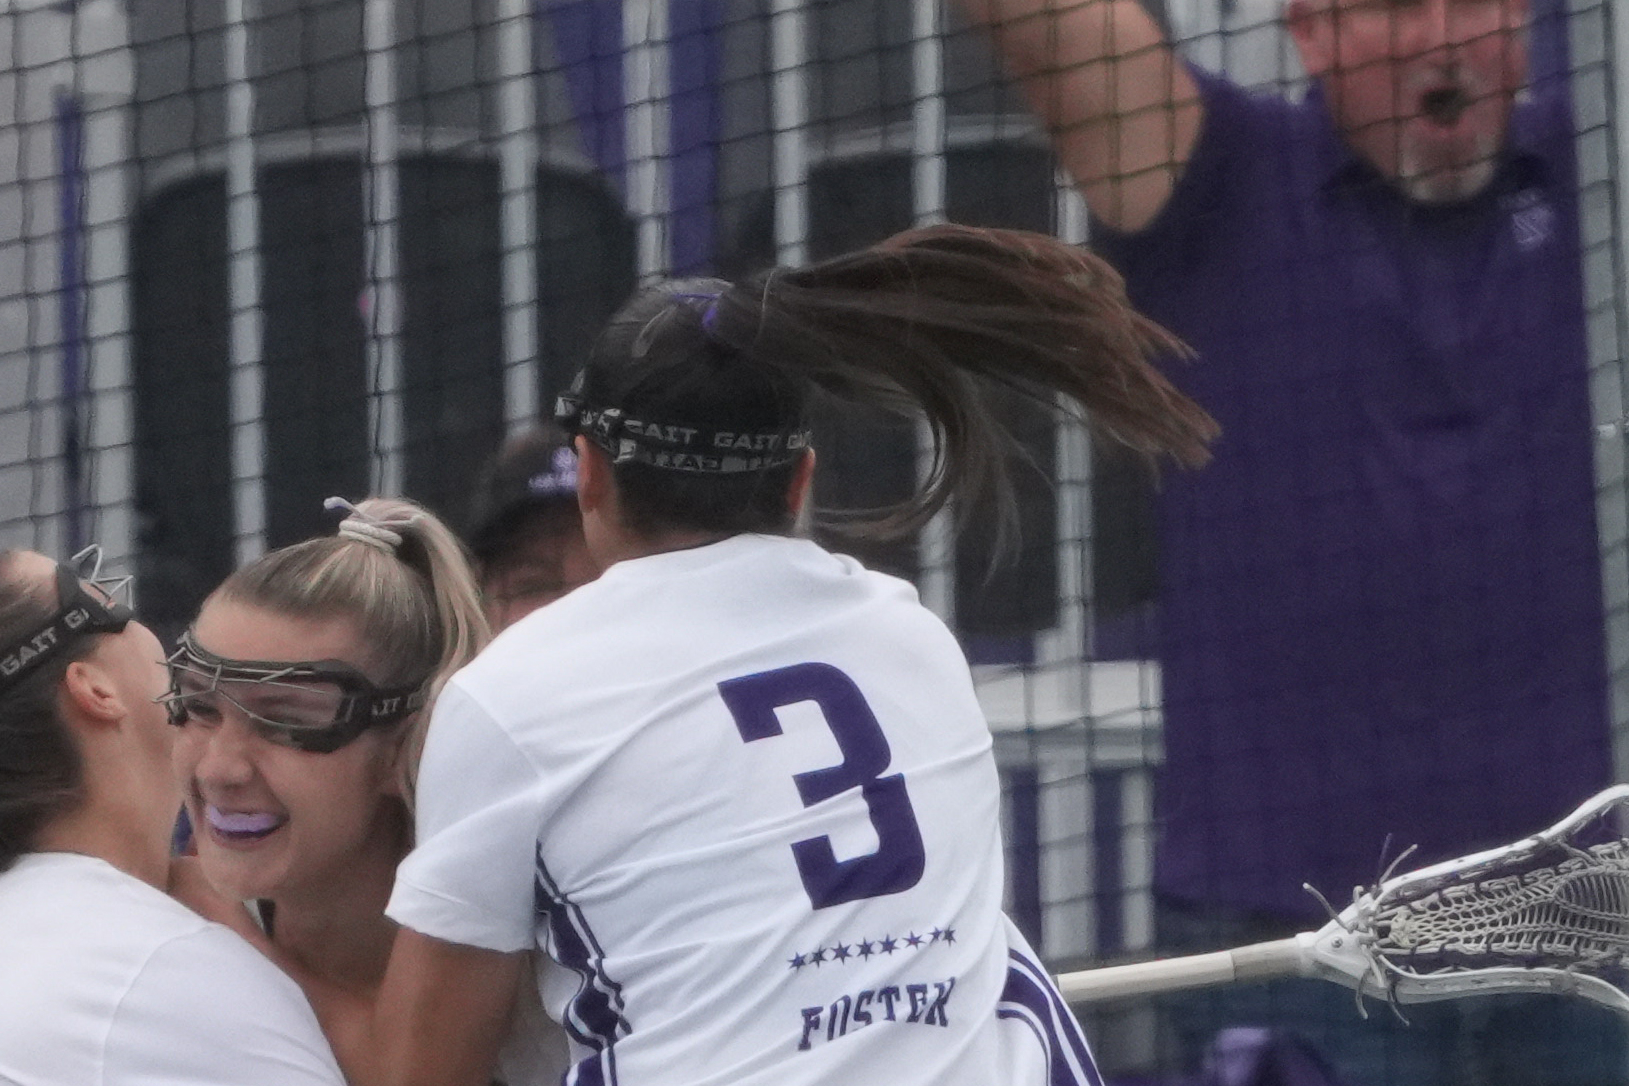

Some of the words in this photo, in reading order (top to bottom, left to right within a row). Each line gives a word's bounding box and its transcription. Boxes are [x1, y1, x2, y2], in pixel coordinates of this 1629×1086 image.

[0, 626, 57, 676] GAIT
[716, 661, 927, 911] 3
[797, 977, 956, 1052] FOSTER
